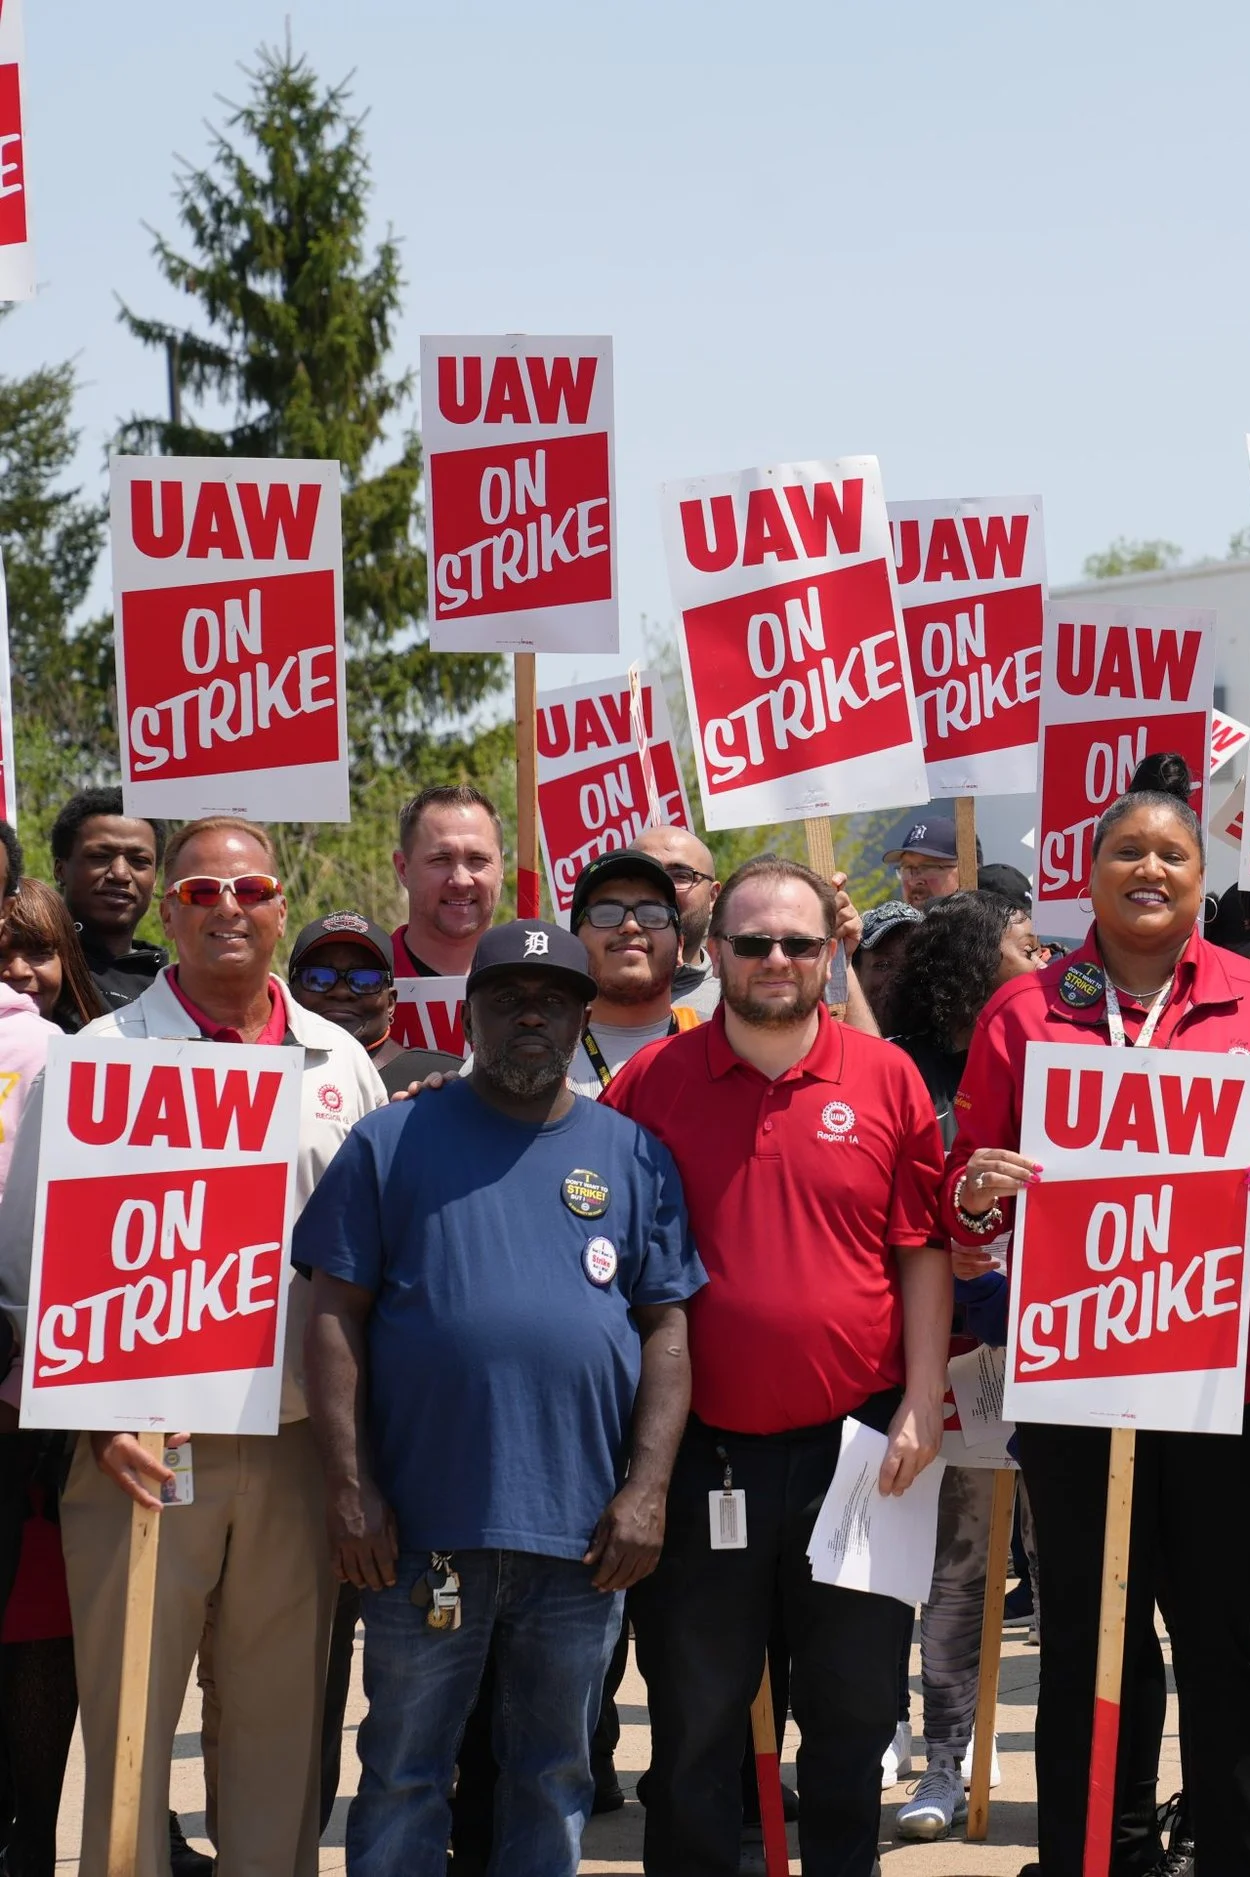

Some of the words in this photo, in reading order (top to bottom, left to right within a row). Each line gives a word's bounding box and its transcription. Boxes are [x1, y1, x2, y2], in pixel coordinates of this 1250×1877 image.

[437, 356, 597, 424] UAW
[131, 480, 321, 560] UAW
[479, 449, 546, 525] ON
[679, 478, 863, 572] UAW
[436, 497, 608, 612] STRIKE
[181, 589, 262, 675] ON
[747, 586, 825, 679] ON
[921, 603, 986, 677] ON
[1057, 623, 1202, 701] UAW
[130, 644, 335, 772] STRIKE
[703, 630, 902, 784] STRIKE
[917, 645, 1041, 748] TRIKE
[580, 763, 634, 830] ON
[1086, 726, 1148, 803] ON
[1065, 972, 1097, 996] STRIKE!
[390, 1000, 466, 1058] AW
[66, 1061, 284, 1152] UAW
[817, 1131, 845, 1142] Region
[849, 1135, 859, 1144] 1A
[831, 1113, 846, 1121] UAW
[1043, 1067, 1244, 1158] UAW
[565, 1178, 584, 1187] DON'T
[583, 1182, 600, 1191] WANT
[601, 1185, 609, 1193] TO
[567, 1184, 606, 1201] STRIKE!
[570, 1194, 582, 1202] BUT
[111, 1180, 207, 1271] ON
[592, 1254, 611, 1269] Strike
[1085, 1184, 1173, 1272] ON
[38, 1242, 281, 1378] STRIKE
[1019, 1245, 1242, 1373] STRIKE
